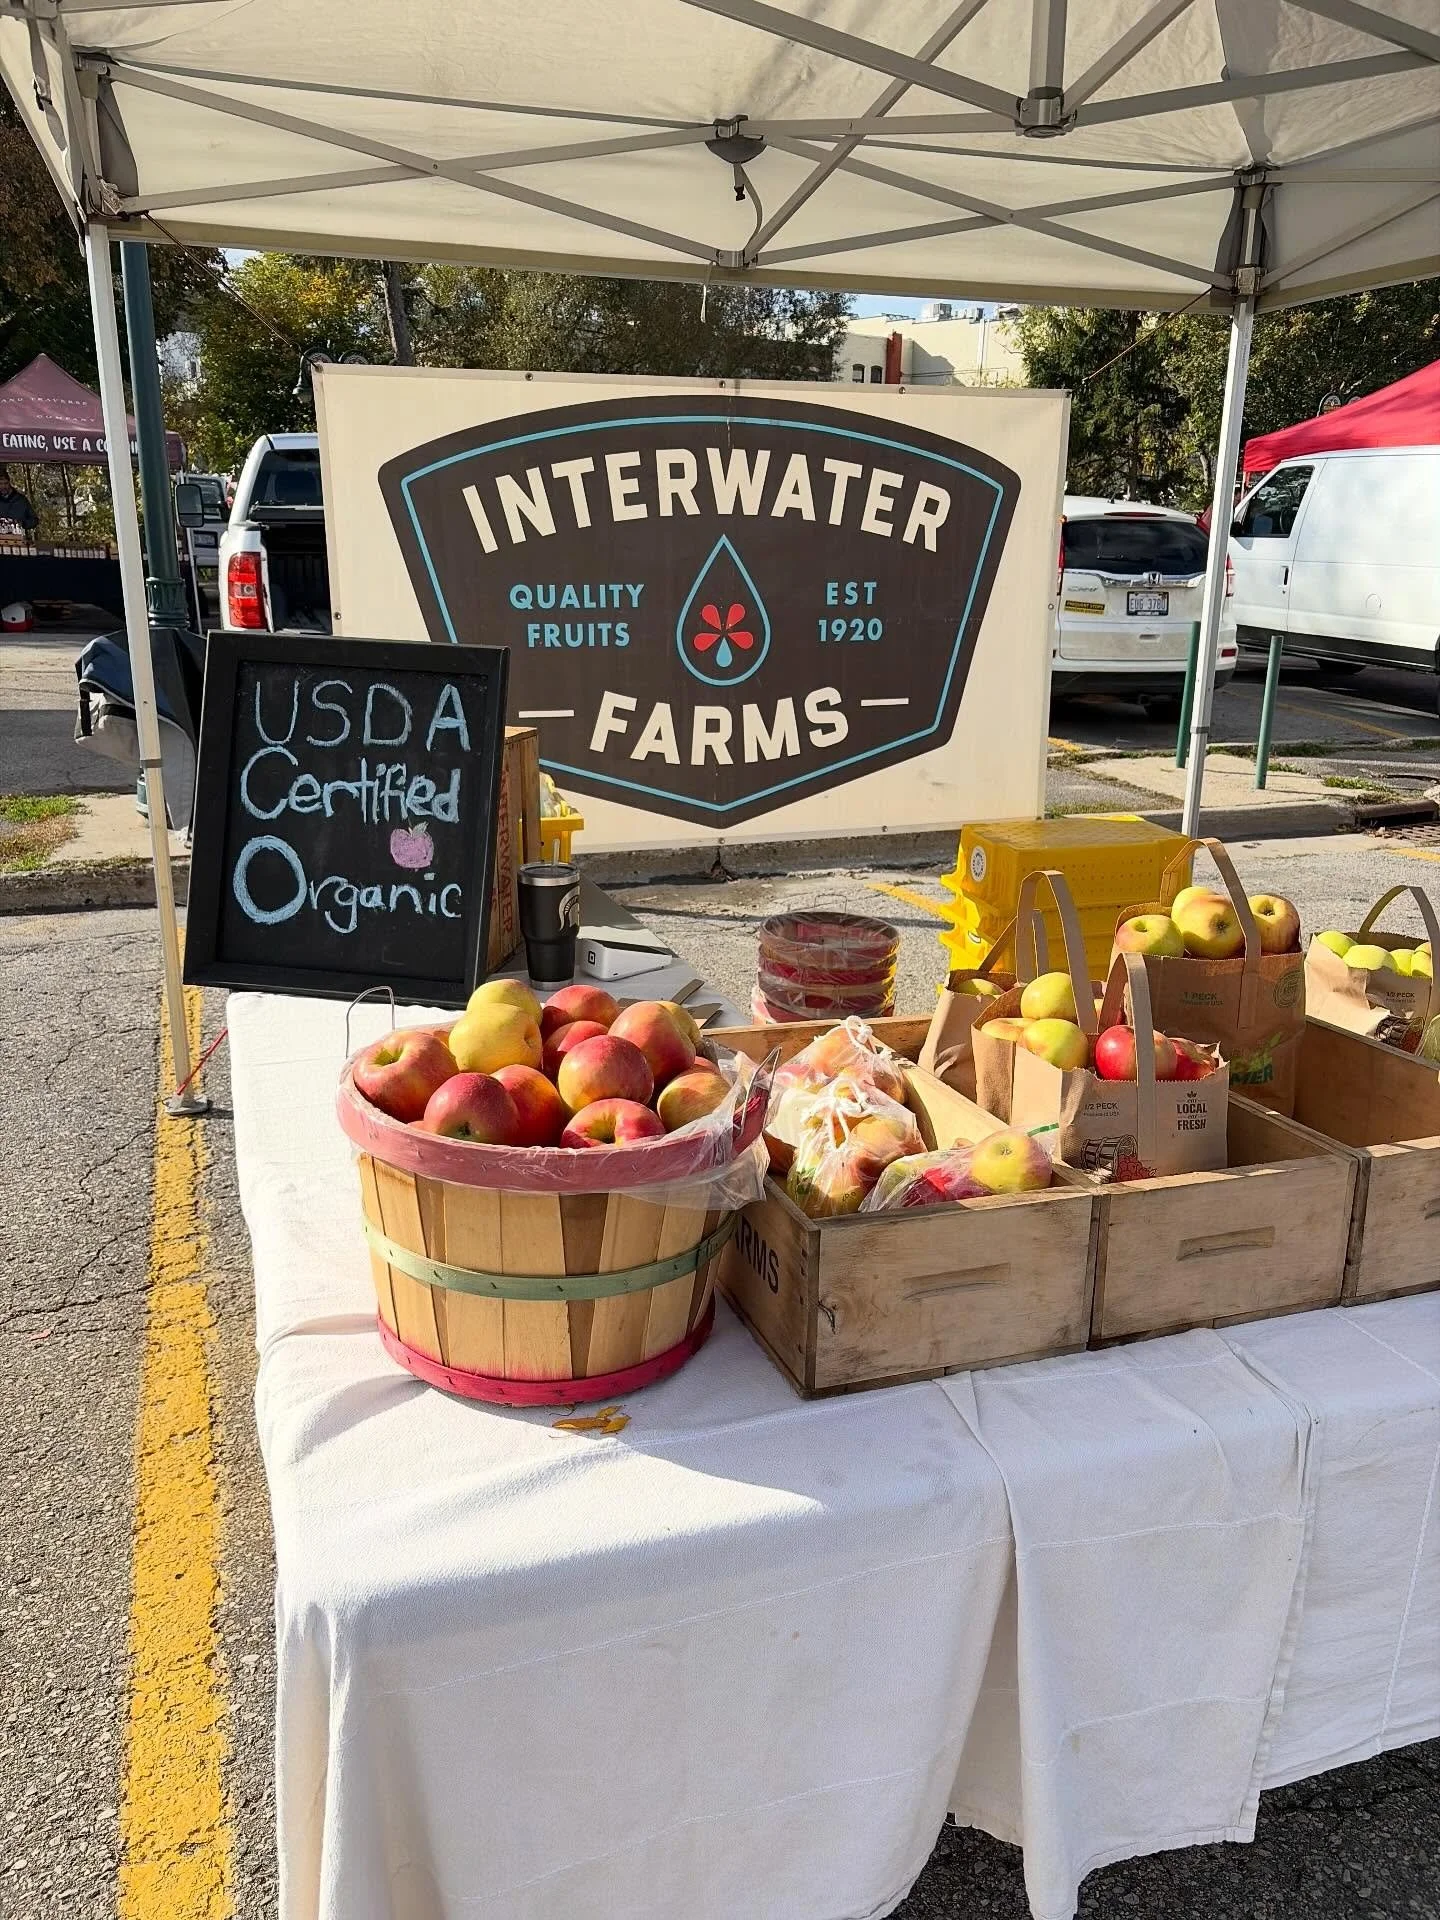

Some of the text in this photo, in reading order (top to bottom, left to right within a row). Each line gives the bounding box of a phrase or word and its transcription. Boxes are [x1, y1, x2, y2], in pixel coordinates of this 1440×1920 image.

[3, 433, 49, 453] EATING,
[53, 435, 77, 451] USE
[83, 438, 92, 452] A
[462, 447, 952, 554] INTERWATER
[509, 583, 645, 610] QUALITY
[825, 581, 878, 606] EST
[526, 622, 631, 649] FRUITS
[817, 618, 884, 643] 1920
[255, 679, 471, 752] USDA
[589, 686, 849, 767] FARMS
[240, 745, 461, 824] Certified
[233, 834, 462, 934] Organic
[1084, 1102, 1118, 1110] 1/2 PECK
[1176, 1103, 1208, 1114] LOCAL
[1177, 1119, 1207, 1131] FRESH
